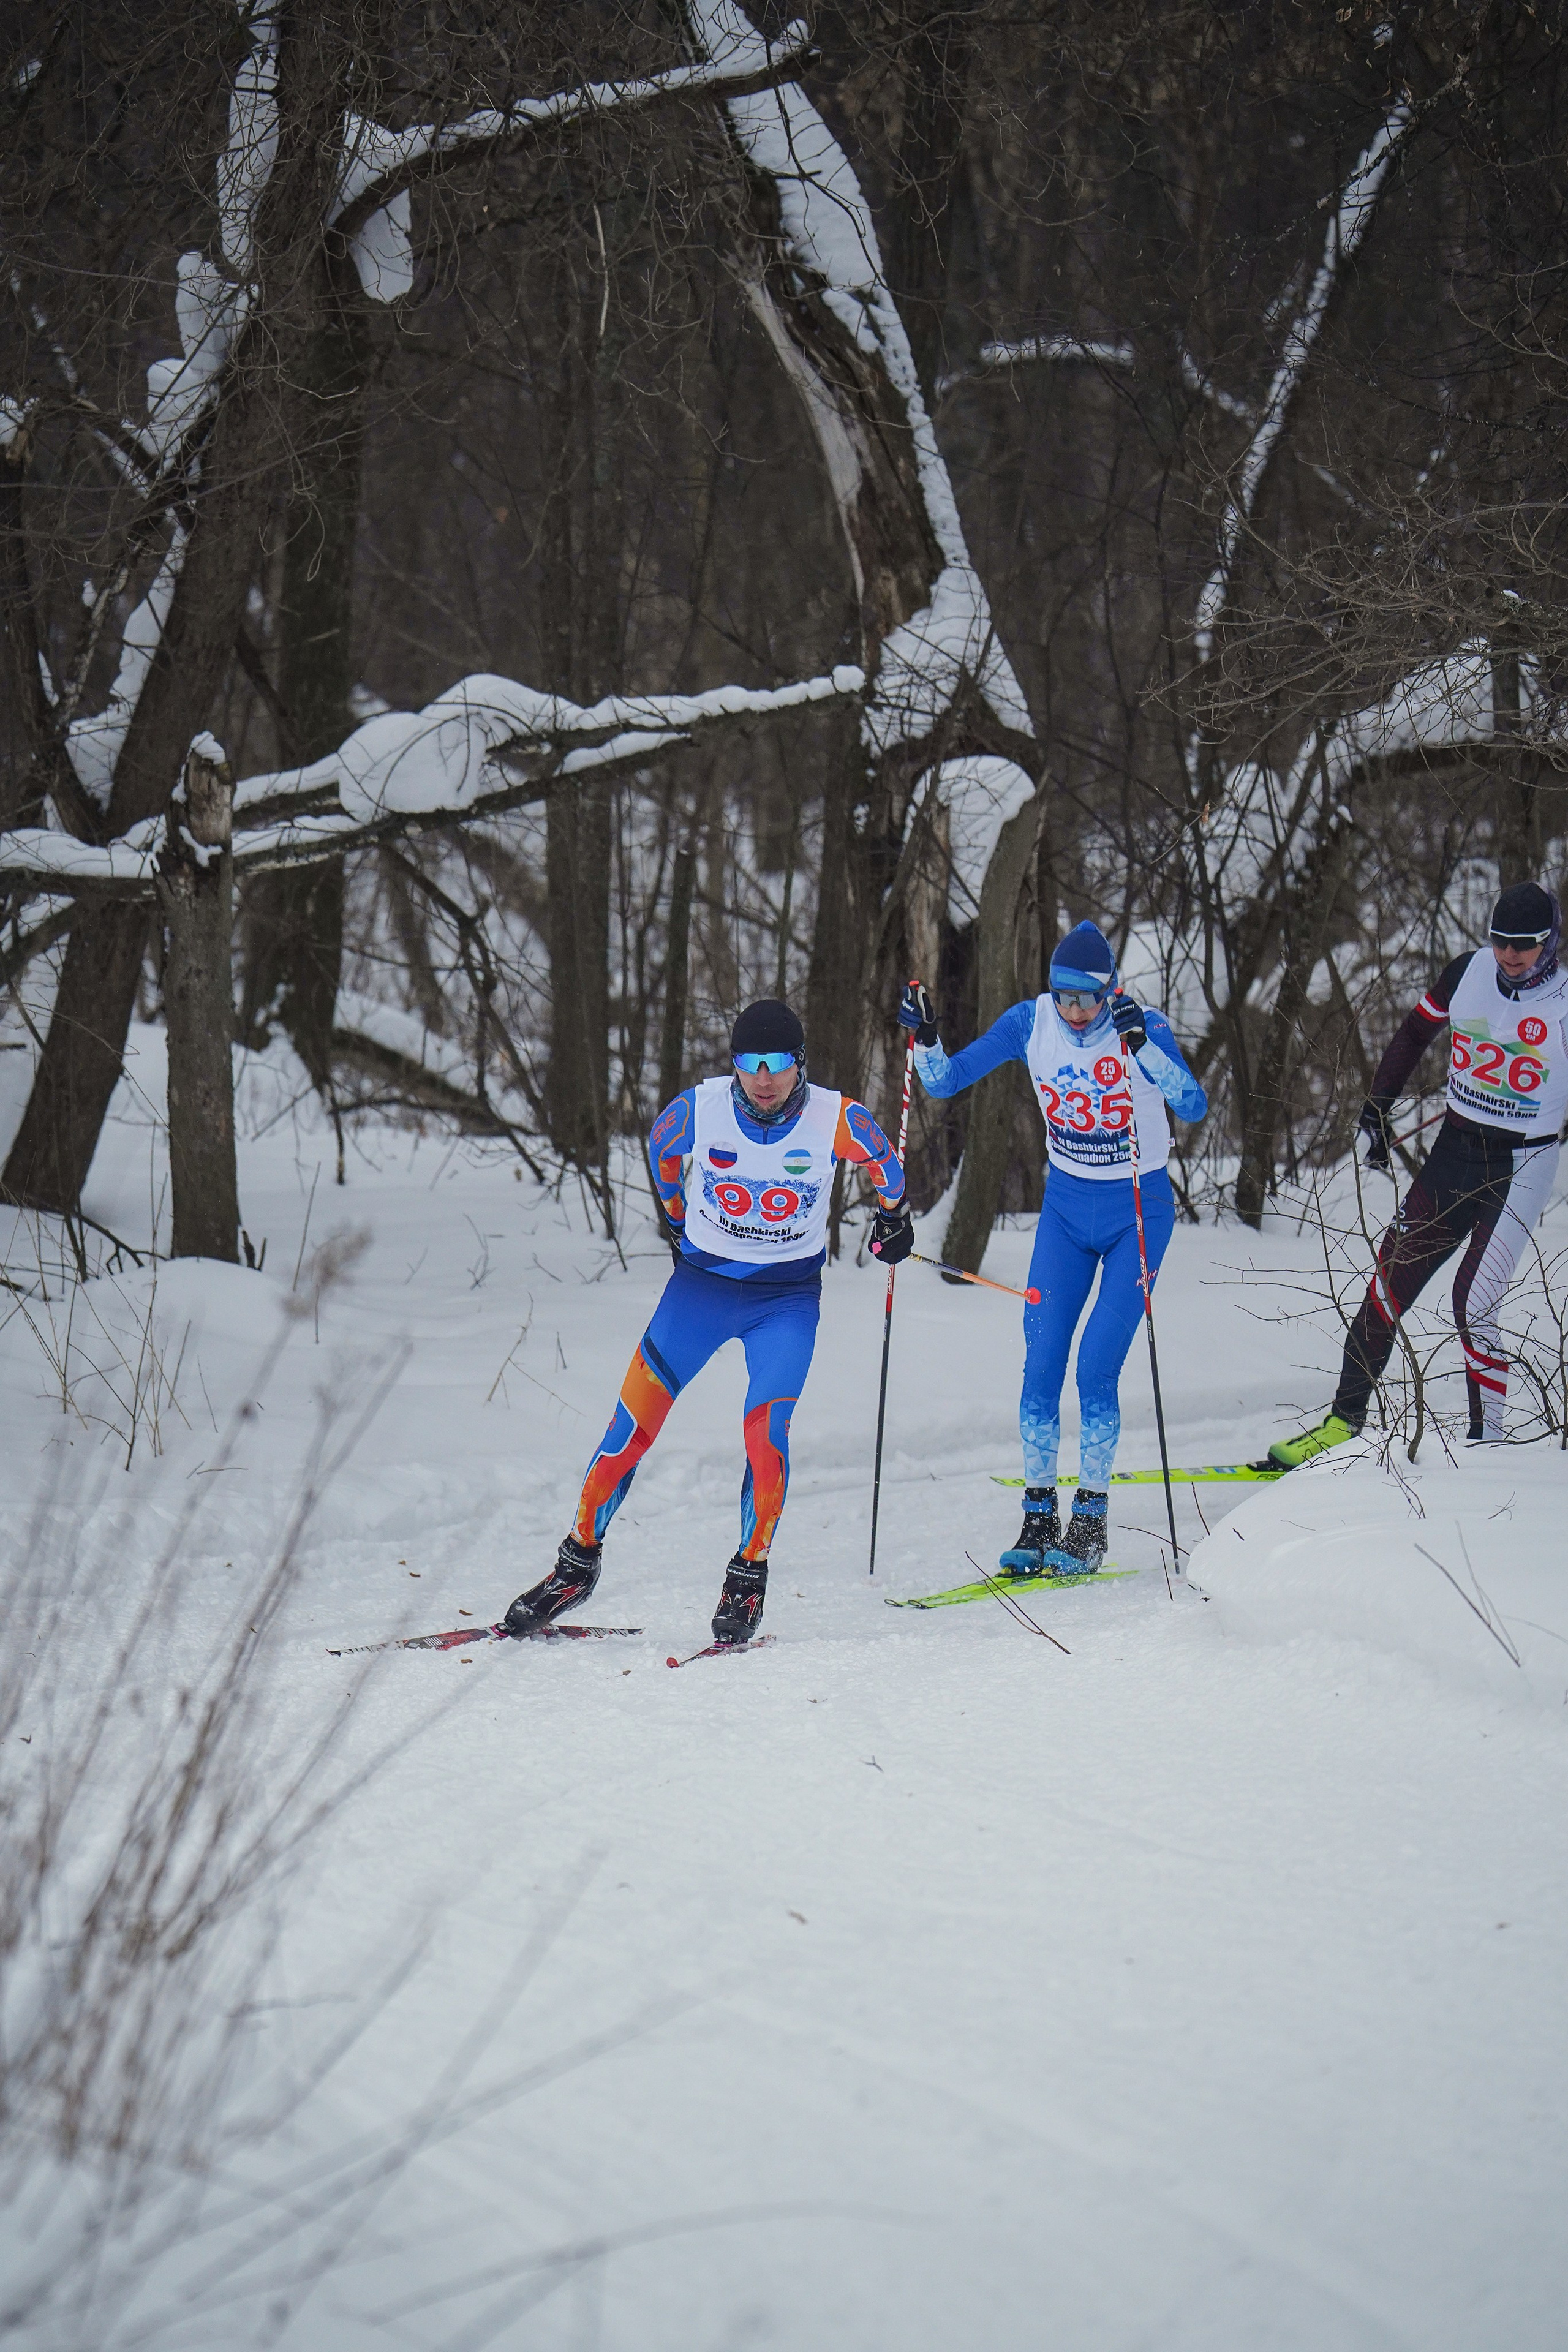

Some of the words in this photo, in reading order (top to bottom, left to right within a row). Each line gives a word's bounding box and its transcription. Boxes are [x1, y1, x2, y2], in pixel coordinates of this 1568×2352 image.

[1525, 1021, 1542, 1036] 50
[1101, 1061, 1115, 1075] 25
[1452, 1031, 1544, 1093] 526
[1457, 1080, 1463, 1092] IV
[1464, 1085, 1516, 1110] BashkirSki
[1040, 1084, 1131, 1132] 235
[1058, 1136, 1065, 1147] IV
[1066, 1140, 1117, 1153] BashkirSki
[1113, 1152, 1139, 1162] 25к
[714, 1183, 799, 1223] 99
[727, 1568, 760, 1579] MADSHUS
